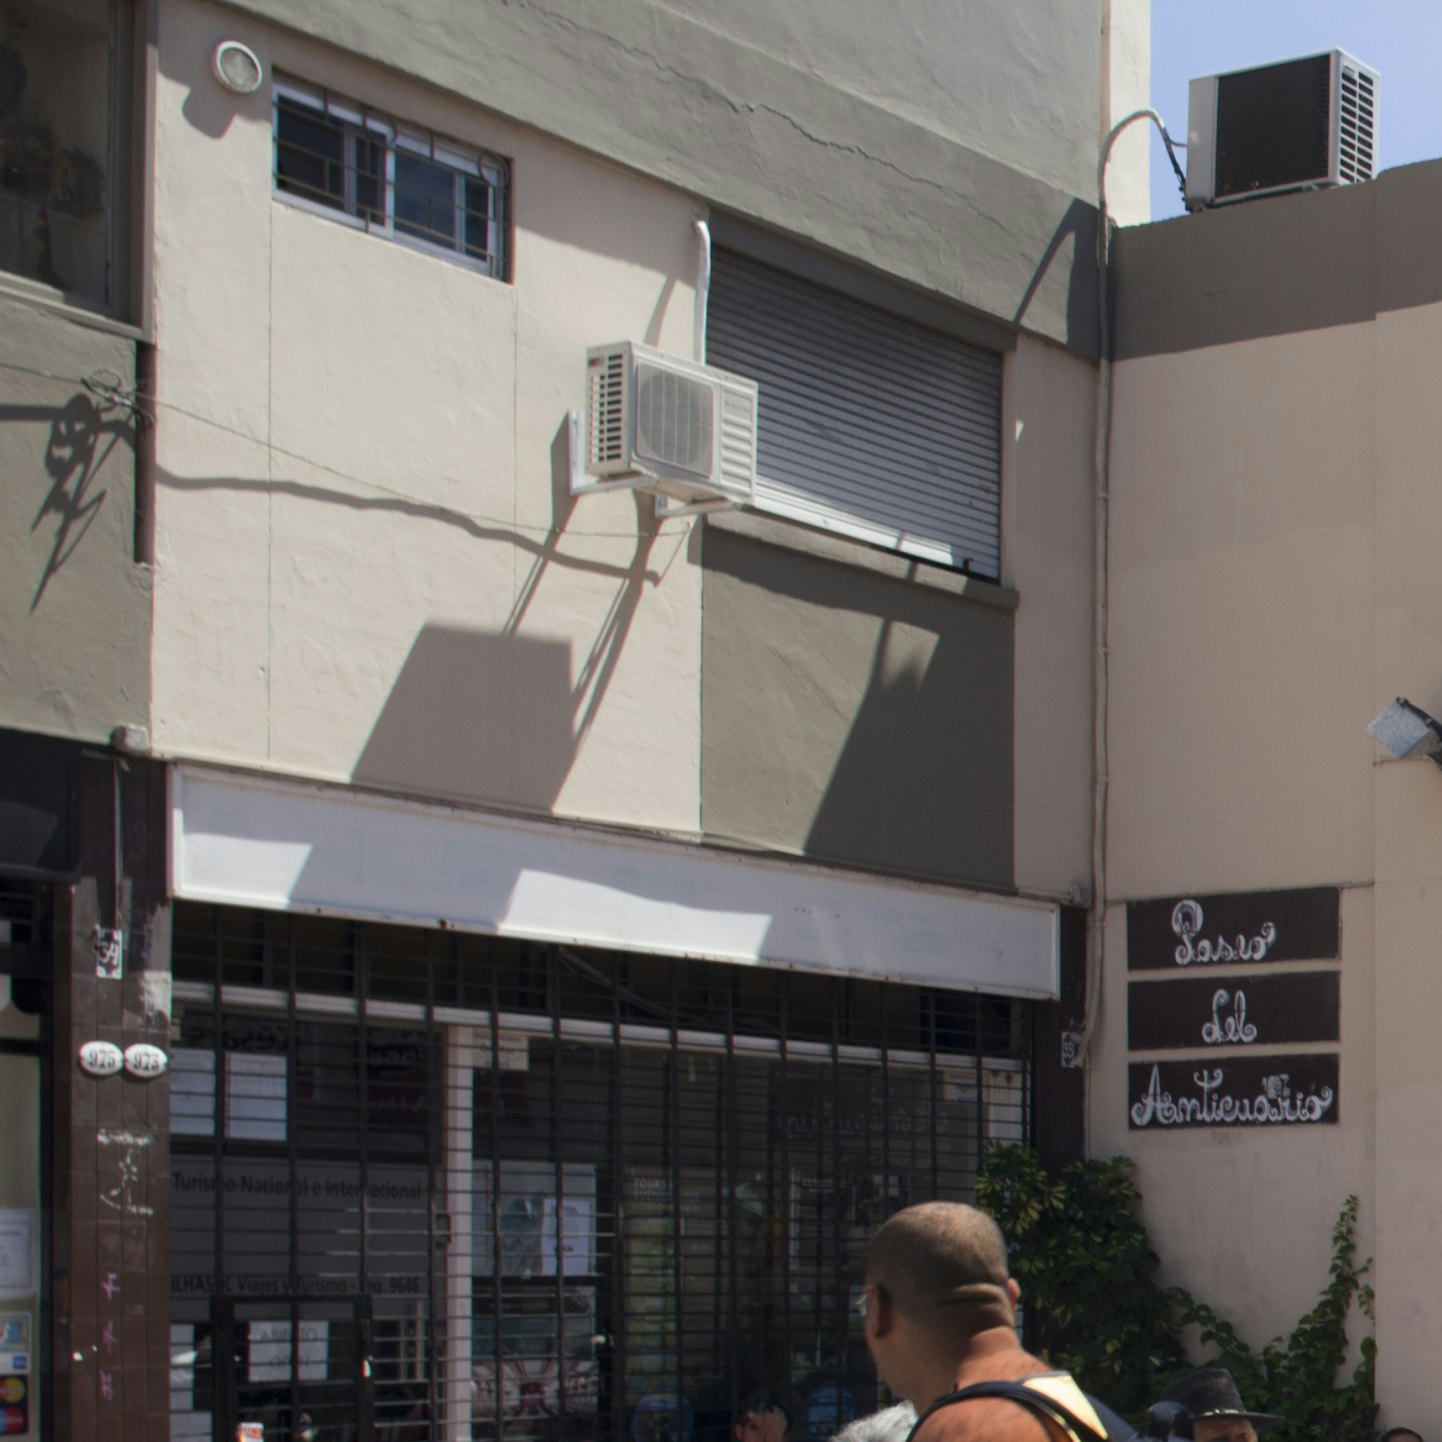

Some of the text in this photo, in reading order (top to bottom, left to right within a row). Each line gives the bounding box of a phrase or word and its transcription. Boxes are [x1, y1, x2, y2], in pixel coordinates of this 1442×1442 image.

[1171, 898, 1278, 965] Paseo
[1201, 988, 1258, 1043] del
[1130, 1063, 1334, 1127] Anticuario
[173, 1172, 237, 1192] Turiso
[237, 1278, 279, 1296] Viajes
[389, 1278, 420, 1293] 9646
[259, 1326, 319, 1342] ABIETO
